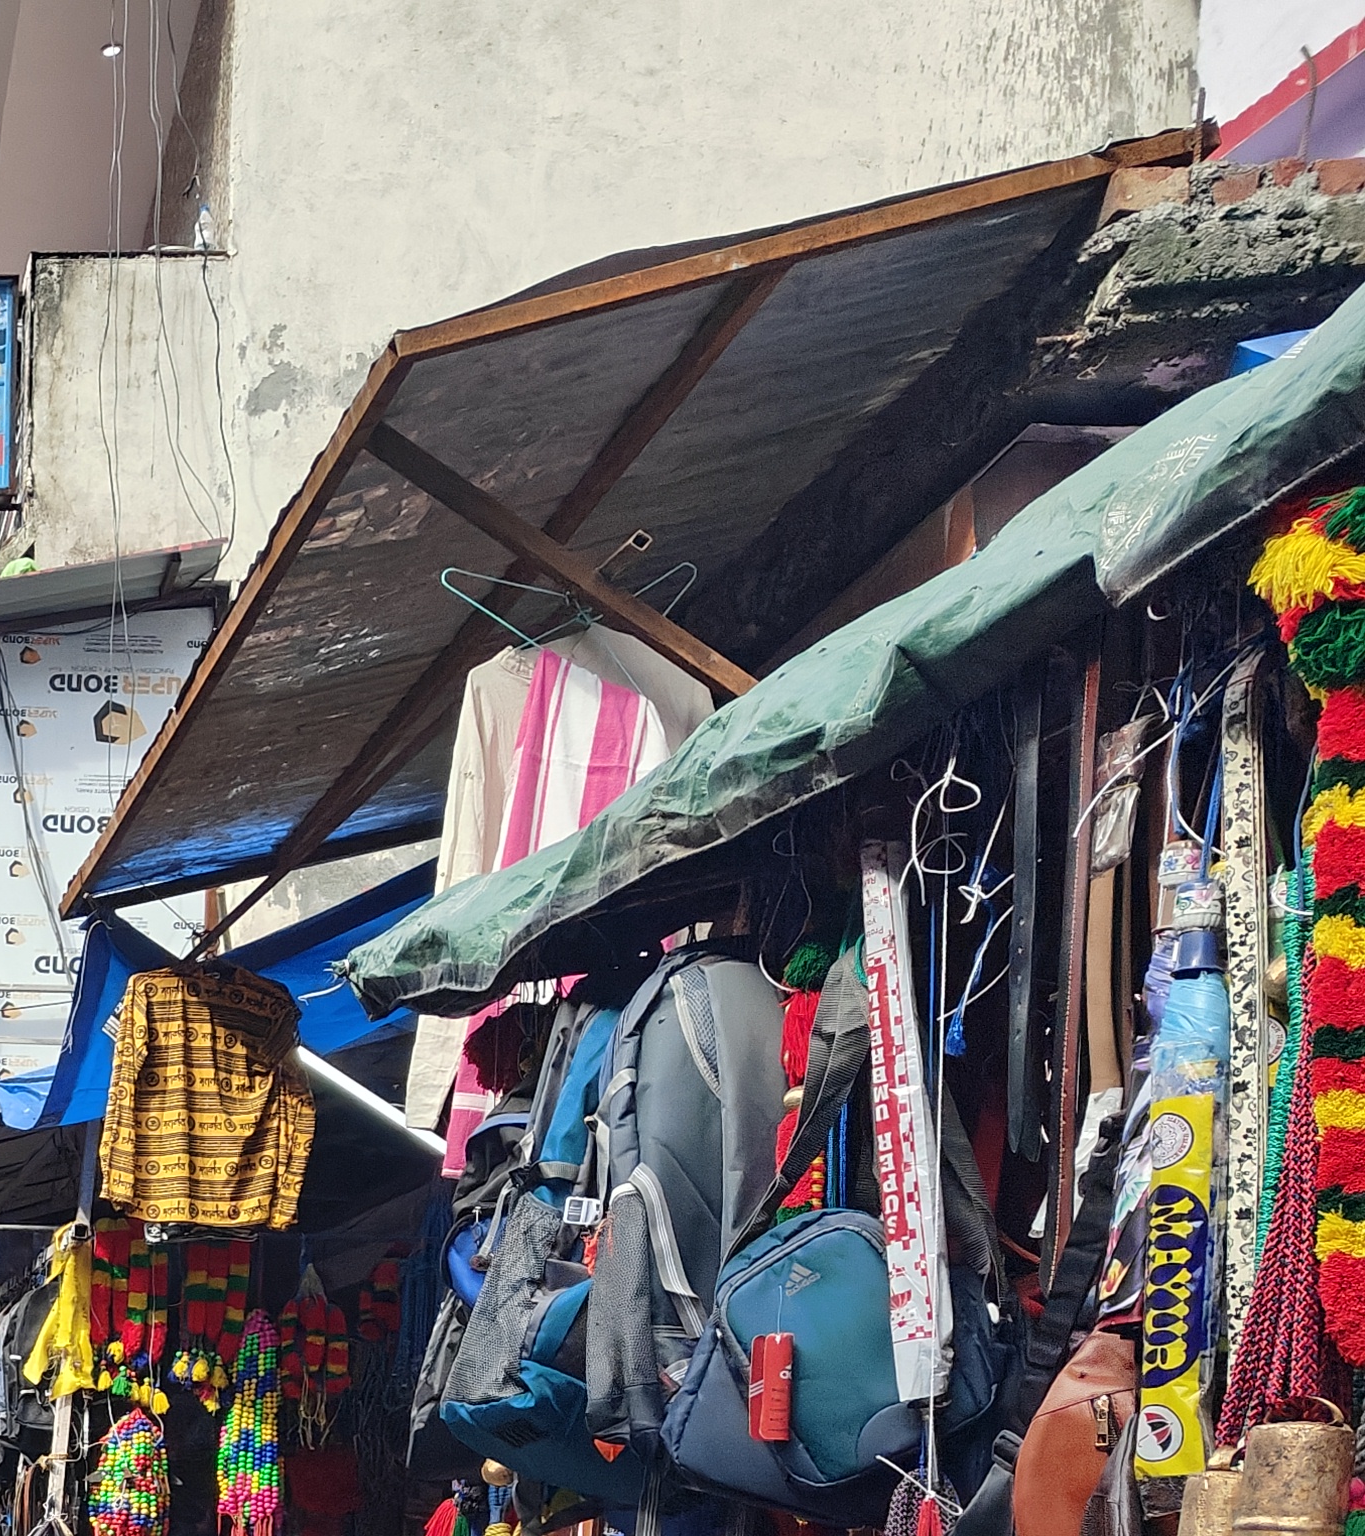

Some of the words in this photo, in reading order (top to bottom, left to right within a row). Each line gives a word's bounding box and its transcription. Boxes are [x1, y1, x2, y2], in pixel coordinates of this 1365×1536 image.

[49, 673, 119, 693] BOND
[122, 675, 185, 695] UPER
[867, 969, 891, 1124] UMBRELLA
[878, 1133, 901, 1237] SUPER
[1143, 1196, 1195, 1376] MAYUR
